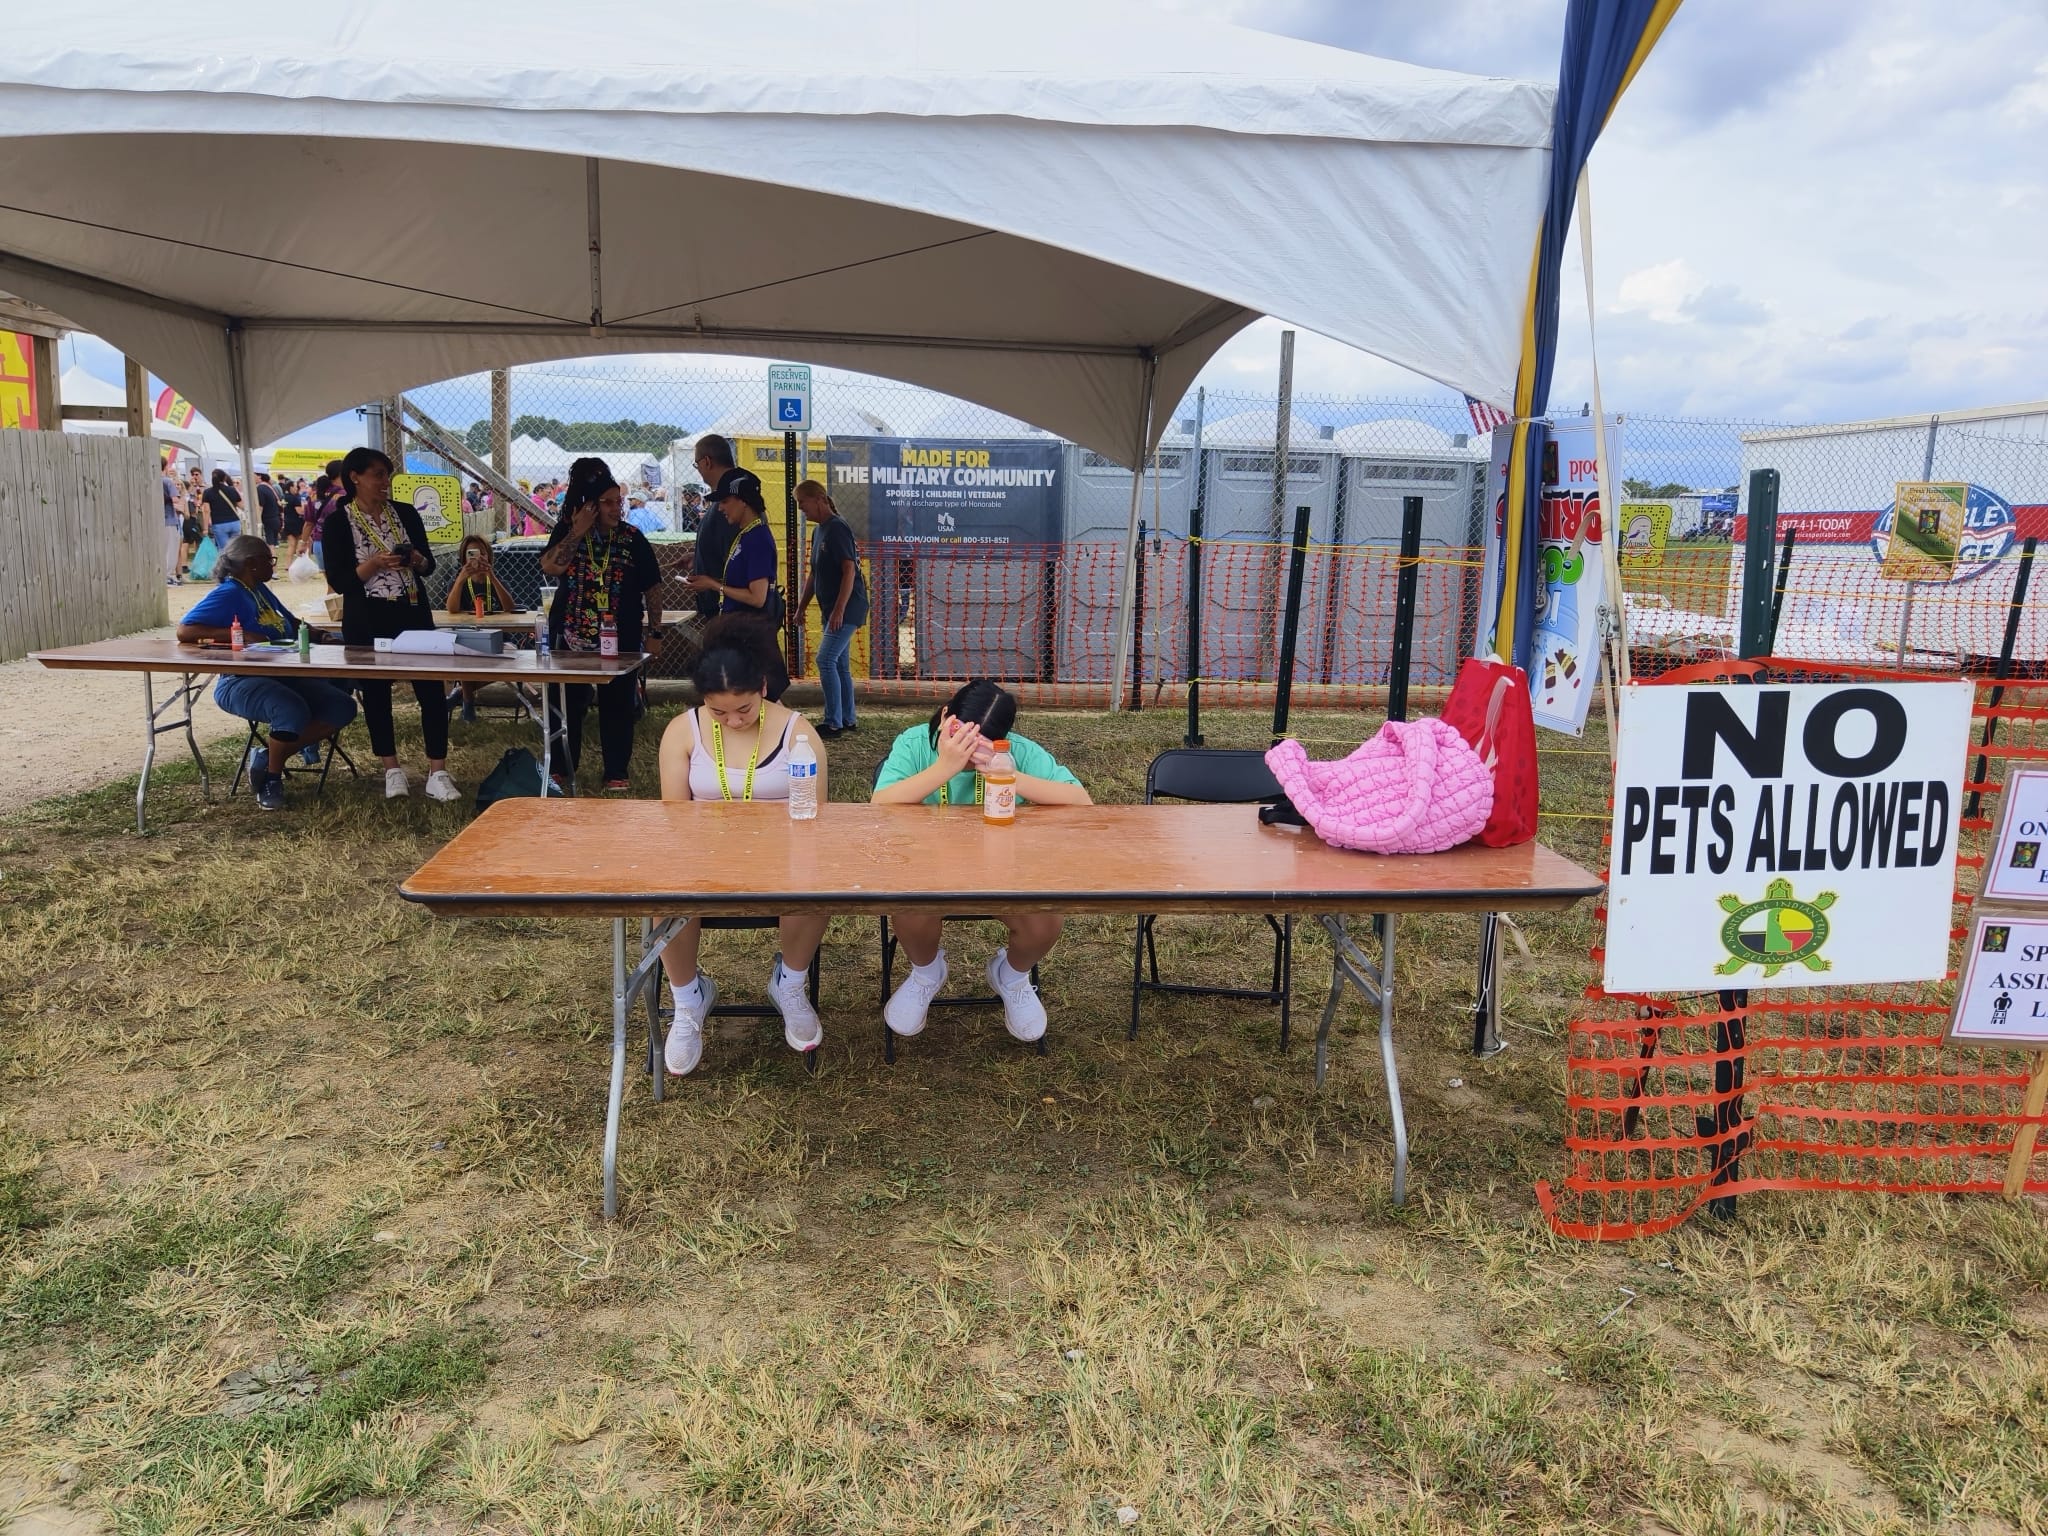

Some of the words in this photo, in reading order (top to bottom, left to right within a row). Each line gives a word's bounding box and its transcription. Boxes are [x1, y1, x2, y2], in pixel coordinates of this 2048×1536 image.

[771, 370, 808, 380] RESERVED
[774, 382, 806, 391] PARKING
[902, 449, 952, 468] MADE
[955, 450, 990, 468] FOR
[835, 465, 870, 484] THE
[872, 467, 950, 486] MILITARY
[953, 468, 1056, 487] COMMUNITY
[885, 489, 920, 498] SPOUSES
[925, 490, 962, 499] CHILDREN
[968, 491, 1006, 499] VETERANS
[912, 500, 943, 508] discharge
[1496, 488, 1602, 544] DRIN
[882, 535, 940, 544] USAA.COM/JOIN
[950, 536, 962, 544] call
[1681, 688, 1907, 780] NO
[714, 729, 723, 764] VOLUNTEER
[719, 768, 731, 801] VOLUNTEER
[1621, 783, 1735, 875] PETS
[1746, 780, 1949, 873] ALLOWED
[1726, 902, 1768, 942] NANTICOKE
[1775, 900, 1819, 918] INDIAN
[1814, 918, 1826, 940] TRIBE
[1743, 948, 1806, 964] DELAWARE
[1989, 972, 2048, 990] ASSI
